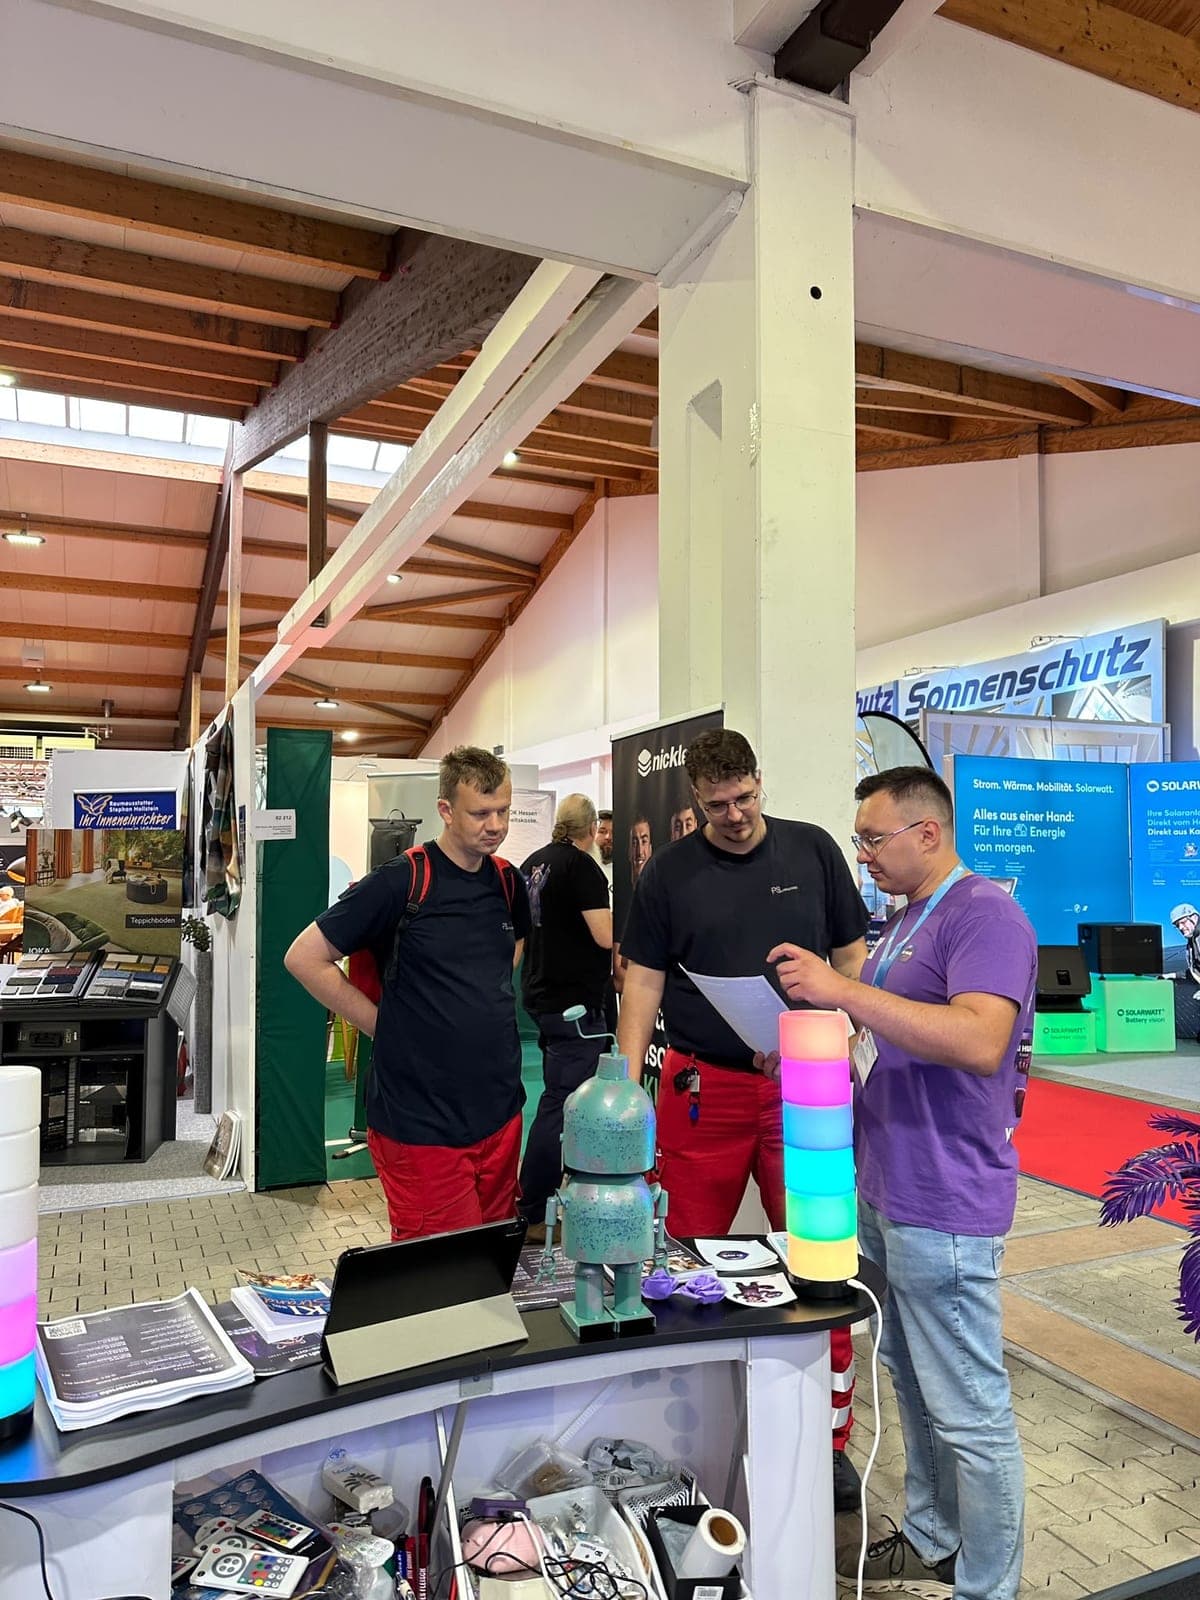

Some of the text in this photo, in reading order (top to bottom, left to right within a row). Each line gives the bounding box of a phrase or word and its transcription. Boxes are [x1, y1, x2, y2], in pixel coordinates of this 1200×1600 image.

[905, 635, 1151, 715] Sonnenschutz
[973, 779, 1114, 793] Strom. Wärme. Mobilität. Solarwatt.
[79, 811, 174, 828] Ihr Inneneinrichter
[973, 808, 1075, 822] Alles aus einer Hand:
[1147, 818, 1171, 826] Direkt
[973, 824, 1066, 840] Für Ihre Energie
[1147, 827, 1172, 836] Direkt
[974, 843, 1036, 856] von morgen.
[1125, 1016, 1147, 1024] Battery
